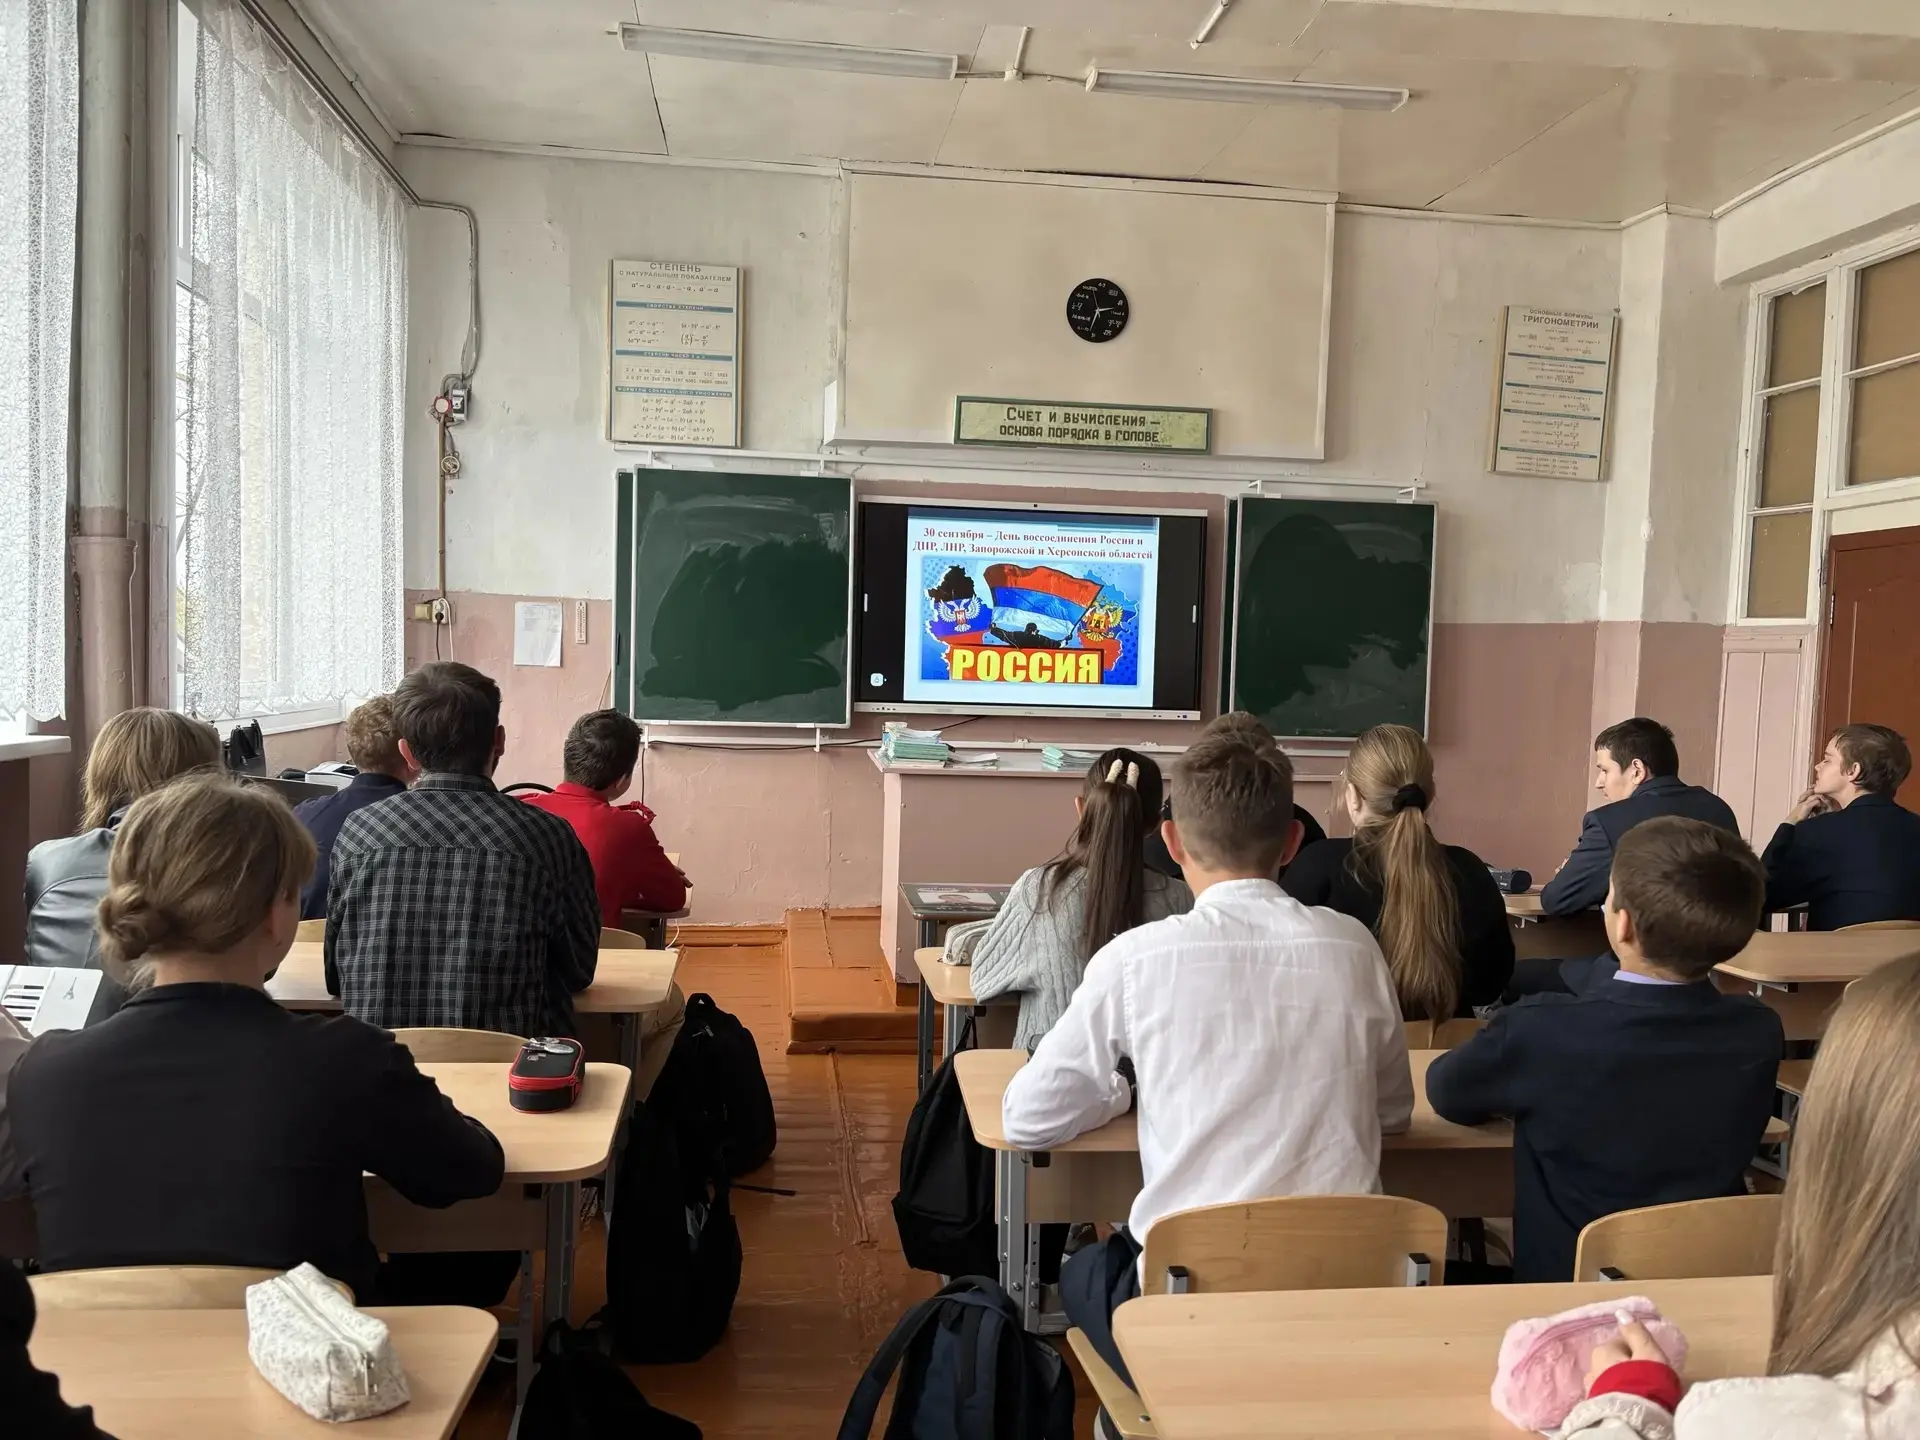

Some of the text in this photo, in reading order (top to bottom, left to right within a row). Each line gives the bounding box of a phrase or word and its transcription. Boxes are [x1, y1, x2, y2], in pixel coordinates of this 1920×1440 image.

[649, 263, 701, 272] СТЕПЕНЬ
[626, 270, 679, 278] НАТУРАЛЬНЫМ
[681, 274, 732, 282] ПОКАЗАТЕЛЕМ
[1523, 315, 1599, 329] ТРИГОНОМЕТРИИ
[1000, 425, 1043, 437] ОСНОВА
[1048, 427, 1099, 441] ПОРЯДКА
[1105, 430, 1111, 440] В
[924, 528, 935, 537] 30
[938, 530, 984, 540] сентября
[994, 530, 1021, 541] День
[1023, 534, 1097, 544] воссоединения
[1100, 535, 1134, 545] России
[913, 541, 938, 552] ДНР,
[941, 543, 967, 553] ЛНР,
[970, 544, 1035, 555] Запорожской
[1048, 546, 1106, 558] Херсонской
[1109, 549, 1153, 559] областей
[952, 648, 1099, 684] РОССИЯ
